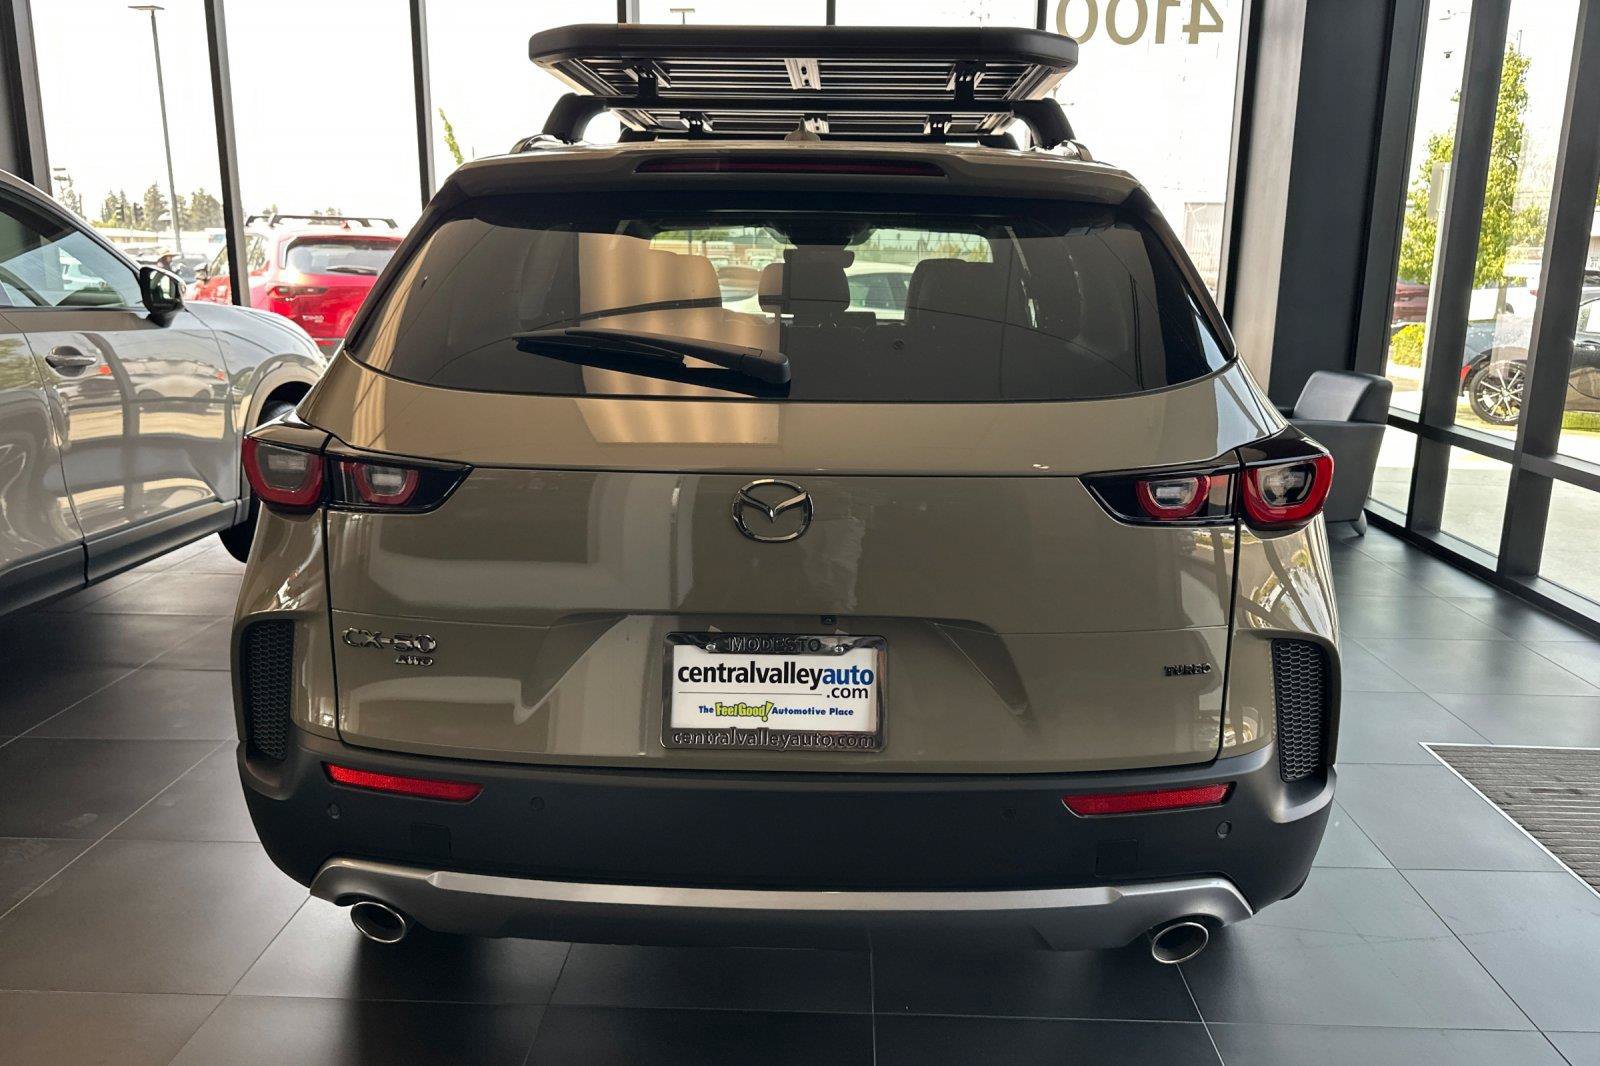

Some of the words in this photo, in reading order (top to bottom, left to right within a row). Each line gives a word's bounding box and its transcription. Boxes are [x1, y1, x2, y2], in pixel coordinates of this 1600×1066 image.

[342, 627, 437, 653] CX-50
[727, 636, 822, 651] MODESTO
[395, 655, 433, 666] AWD
[677, 660, 875, 690] centralvalleyauto
[1164, 662, 1211, 676] TURBO
[698, 705, 714, 714] The
[772, 706, 826, 716] Automotive
[829, 706, 854, 716] Place
[672, 727, 876, 749] centralvalleyauto.com
